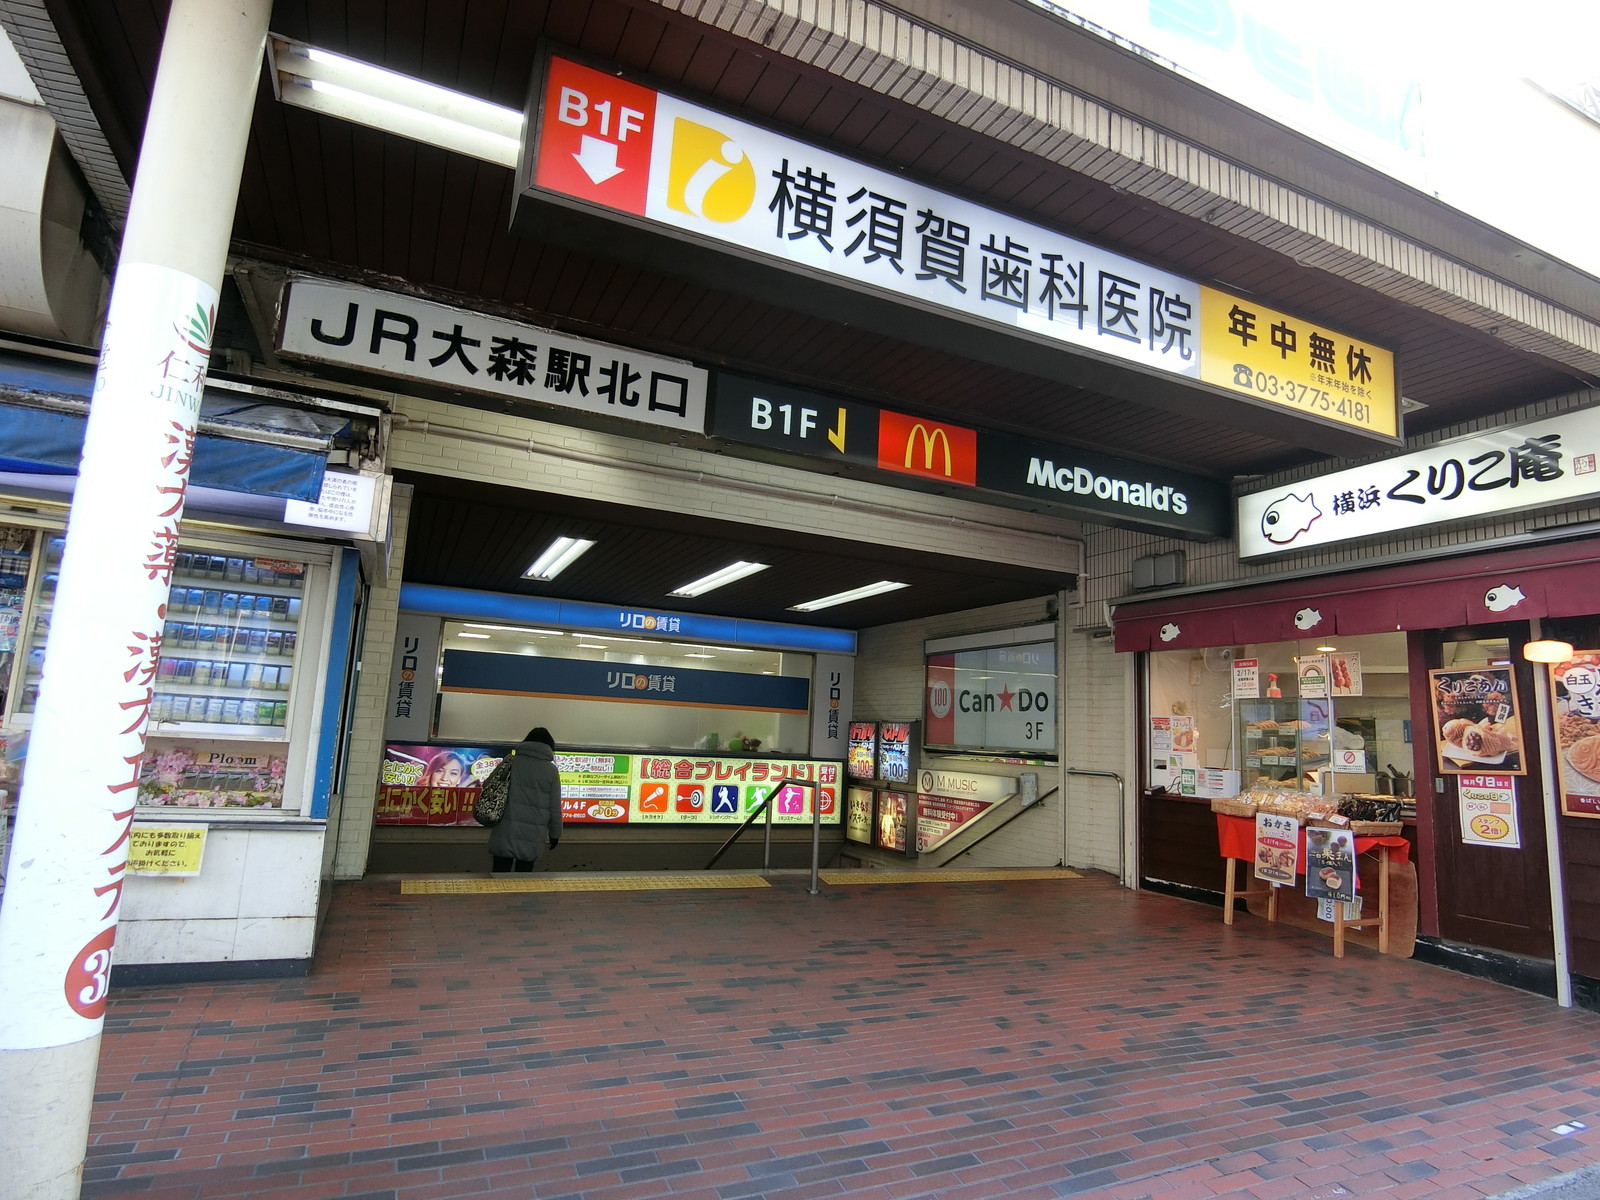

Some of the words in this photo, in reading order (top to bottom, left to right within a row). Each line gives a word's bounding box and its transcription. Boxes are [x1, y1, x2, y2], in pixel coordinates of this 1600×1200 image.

[557, 86, 645, 142] B1F
[769, 158, 1193, 360] 横須賀歯科医院
[310, 302, 690, 418] JR大森駅北口
[1228, 304, 1373, 385] 年中無休
[751, 397, 818, 439] B1F
[1026, 457, 1188, 516] McDonald's
[1332, 485, 1382, 517] 横浜
[1386, 434, 1565, 505] くりこ庵
[619, 611, 681, 634] リロの賃貸
[394, 636, 420, 719] リロの賃貸
[607, 671, 676, 693] リロの賃貸
[1565, 674, 1593, 686] 白玉
[827, 671, 842, 740] リロの賃貸
[1025, 722, 1044, 740] 3F
[383, 760, 424, 776] とにかく
[947, 778, 978, 792] MUSIC
[1262, 817, 1292, 831] おかき
